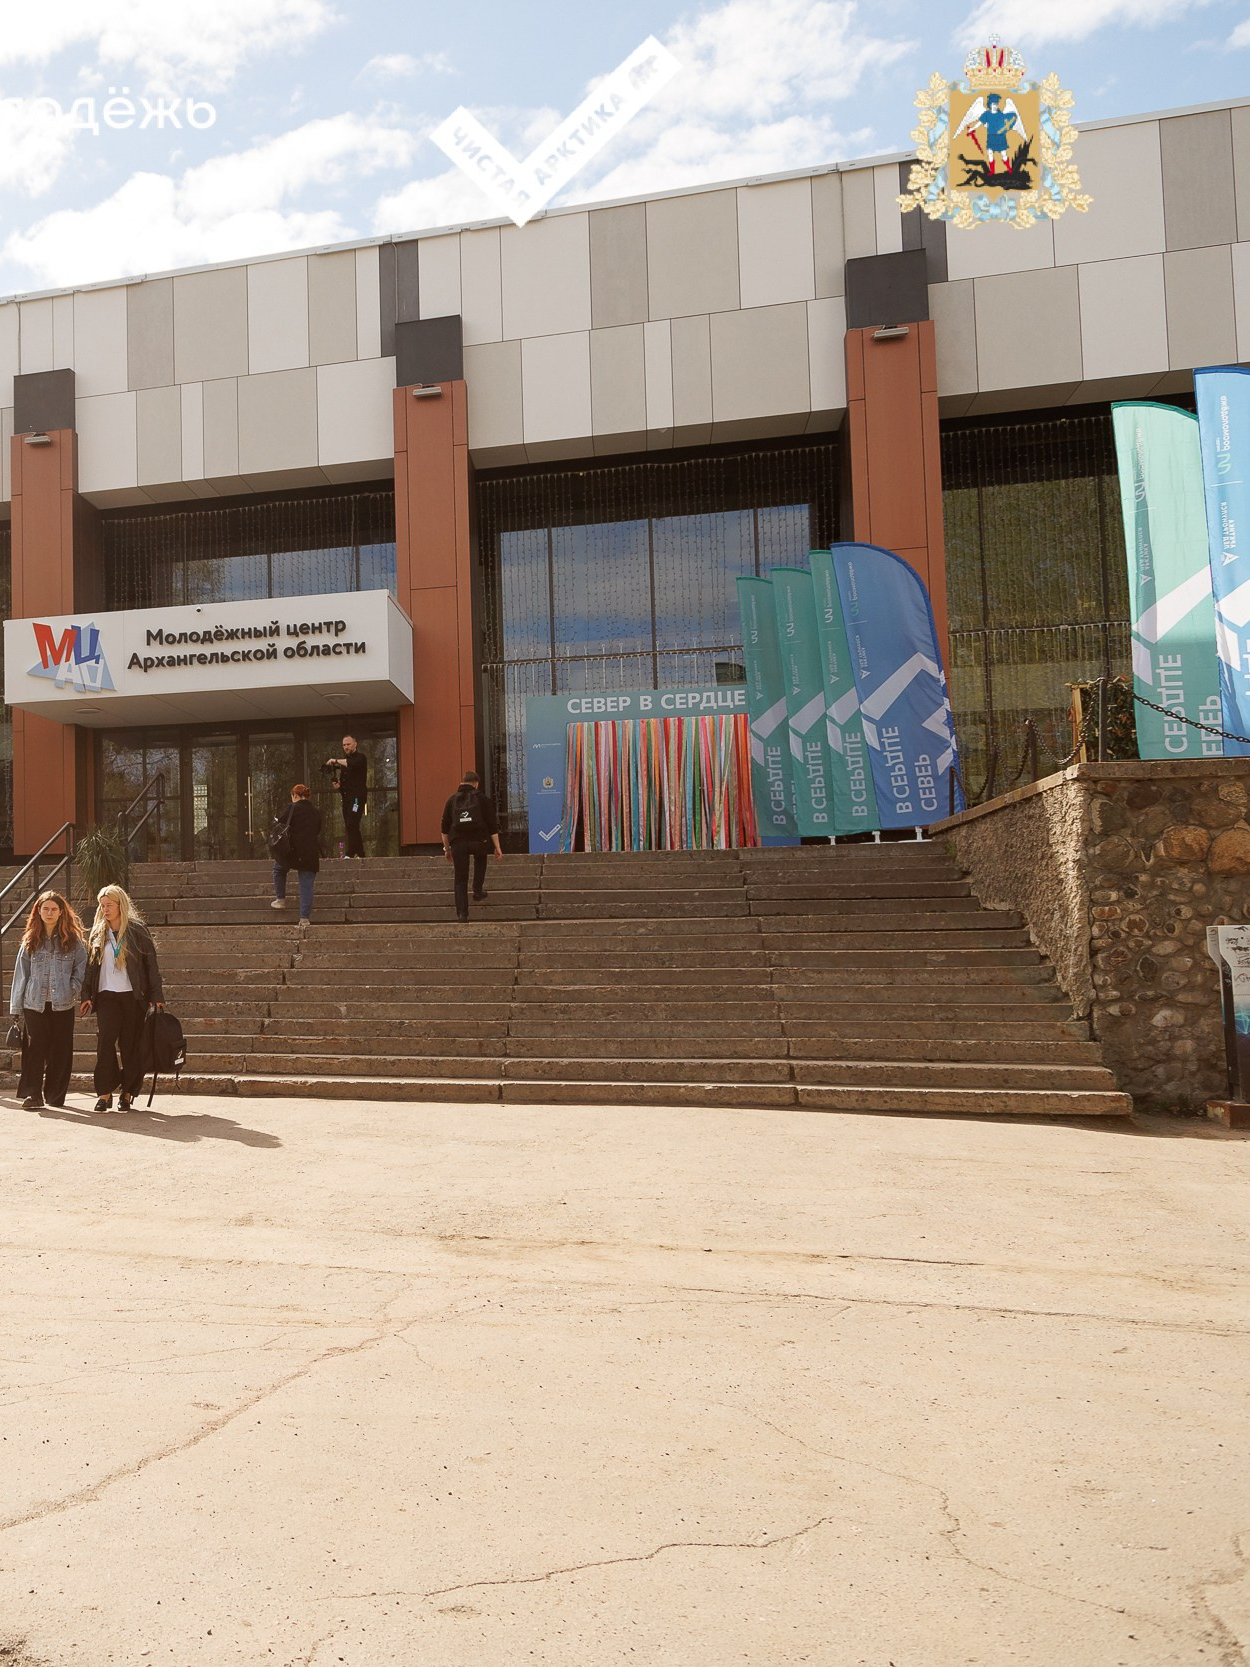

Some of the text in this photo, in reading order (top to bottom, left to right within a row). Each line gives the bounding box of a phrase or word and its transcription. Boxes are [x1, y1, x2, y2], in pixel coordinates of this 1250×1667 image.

[146, 618, 346, 646] Молодёжный центр
[127, 639, 366, 673] Архангельской области
[567, 690, 746, 714] СЕВЕР В СЕРДЦЕ
